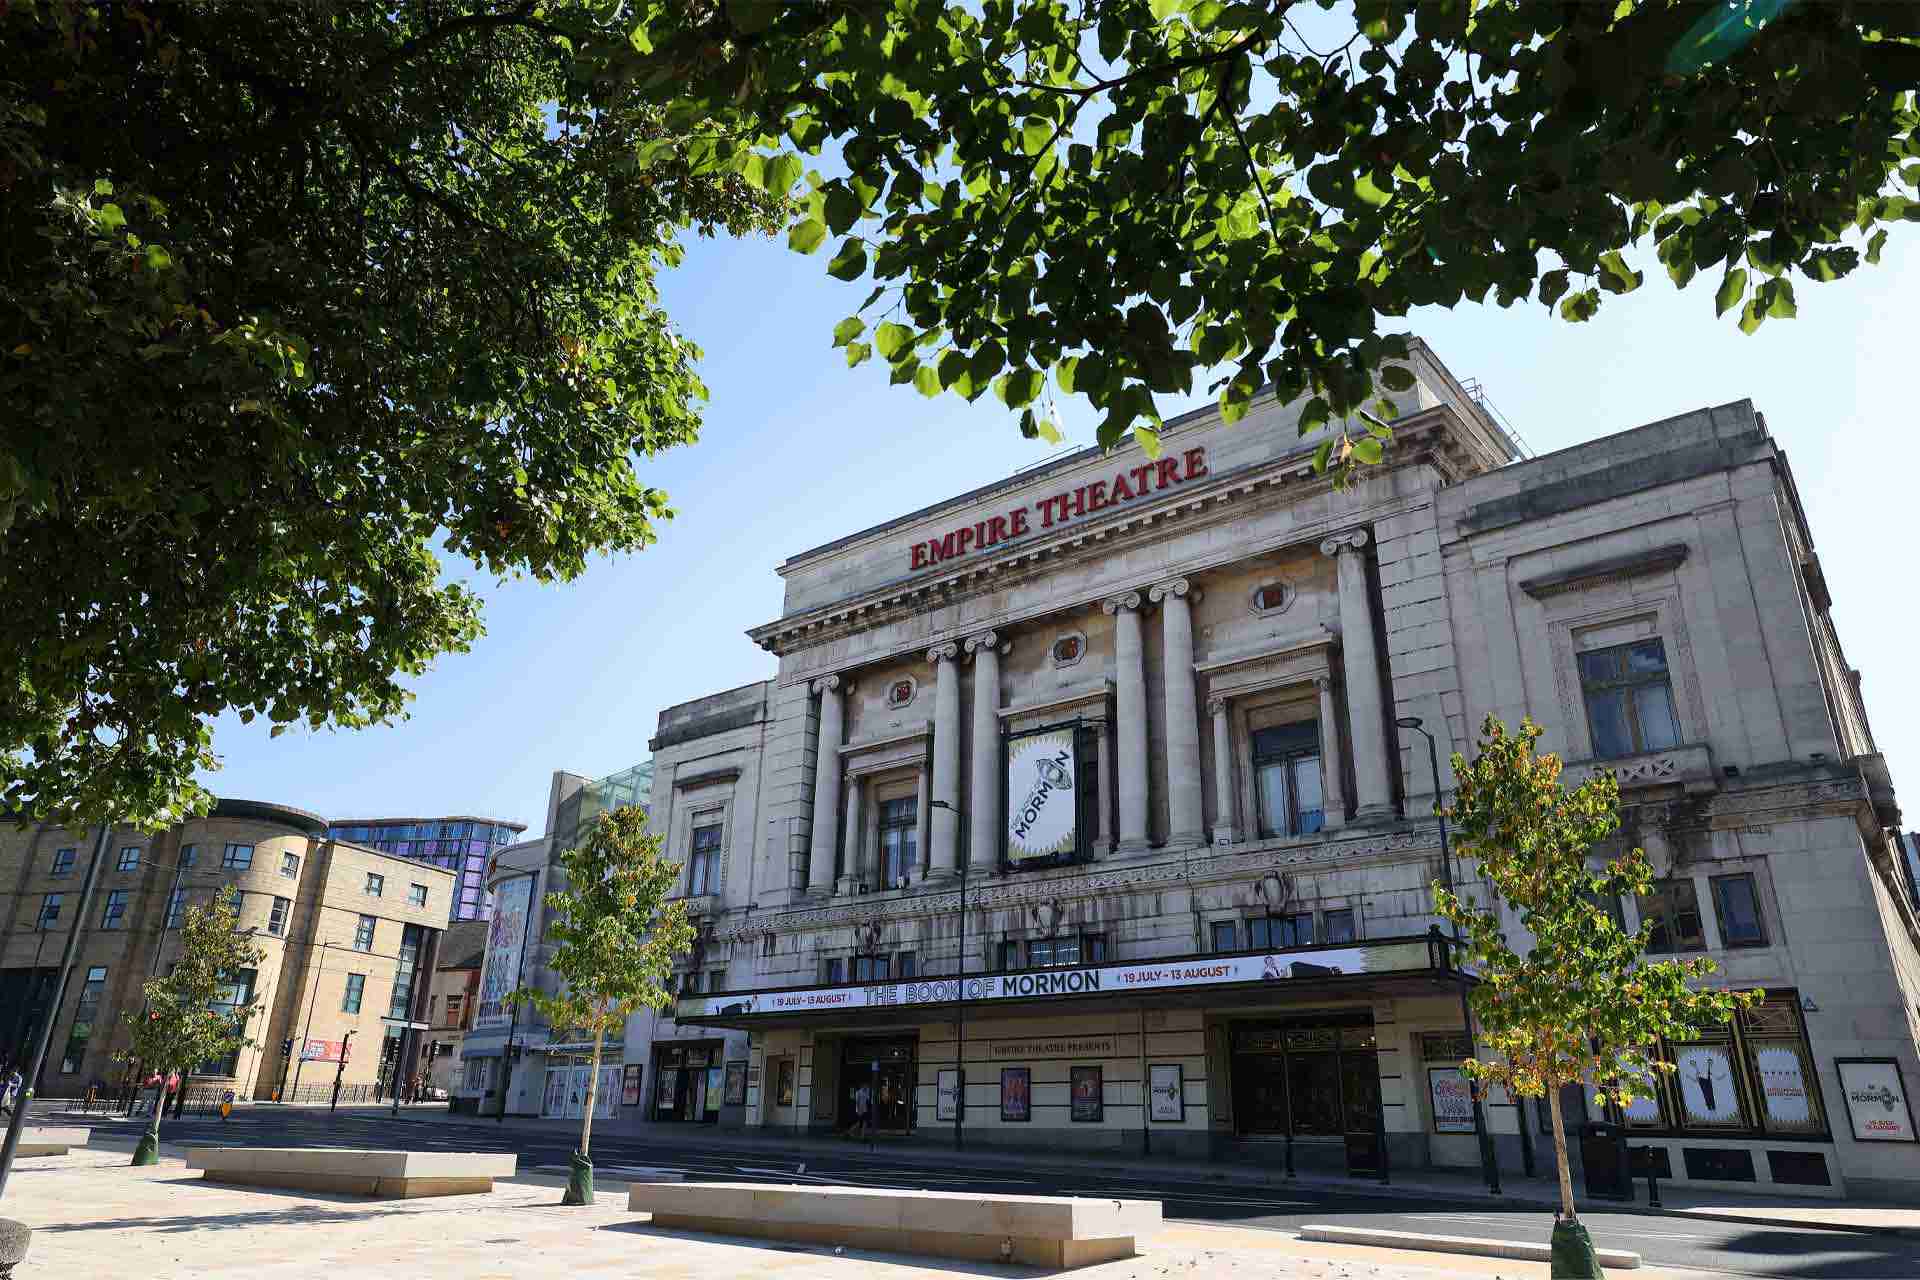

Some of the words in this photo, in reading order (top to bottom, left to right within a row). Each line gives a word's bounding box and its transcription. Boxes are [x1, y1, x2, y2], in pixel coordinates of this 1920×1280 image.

[909, 507, 1029, 570] EMPIRE
[1036, 447, 1208, 529] THEATRE
[1123, 973, 1135, 983] 19
[1136, 970, 1162, 982] JULY
[1171, 969, 1181, 980] 13
[1184, 966, 1231, 979] AUGUST
[785, 996, 801, 1006] JULY
[816, 993, 846, 1004] AUGUST
[863, 985, 898, 1005] THE
[906, 979, 961, 1002] BOOK
[967, 978, 995, 999] OF
[1003, 971, 1100, 996] MORMON
